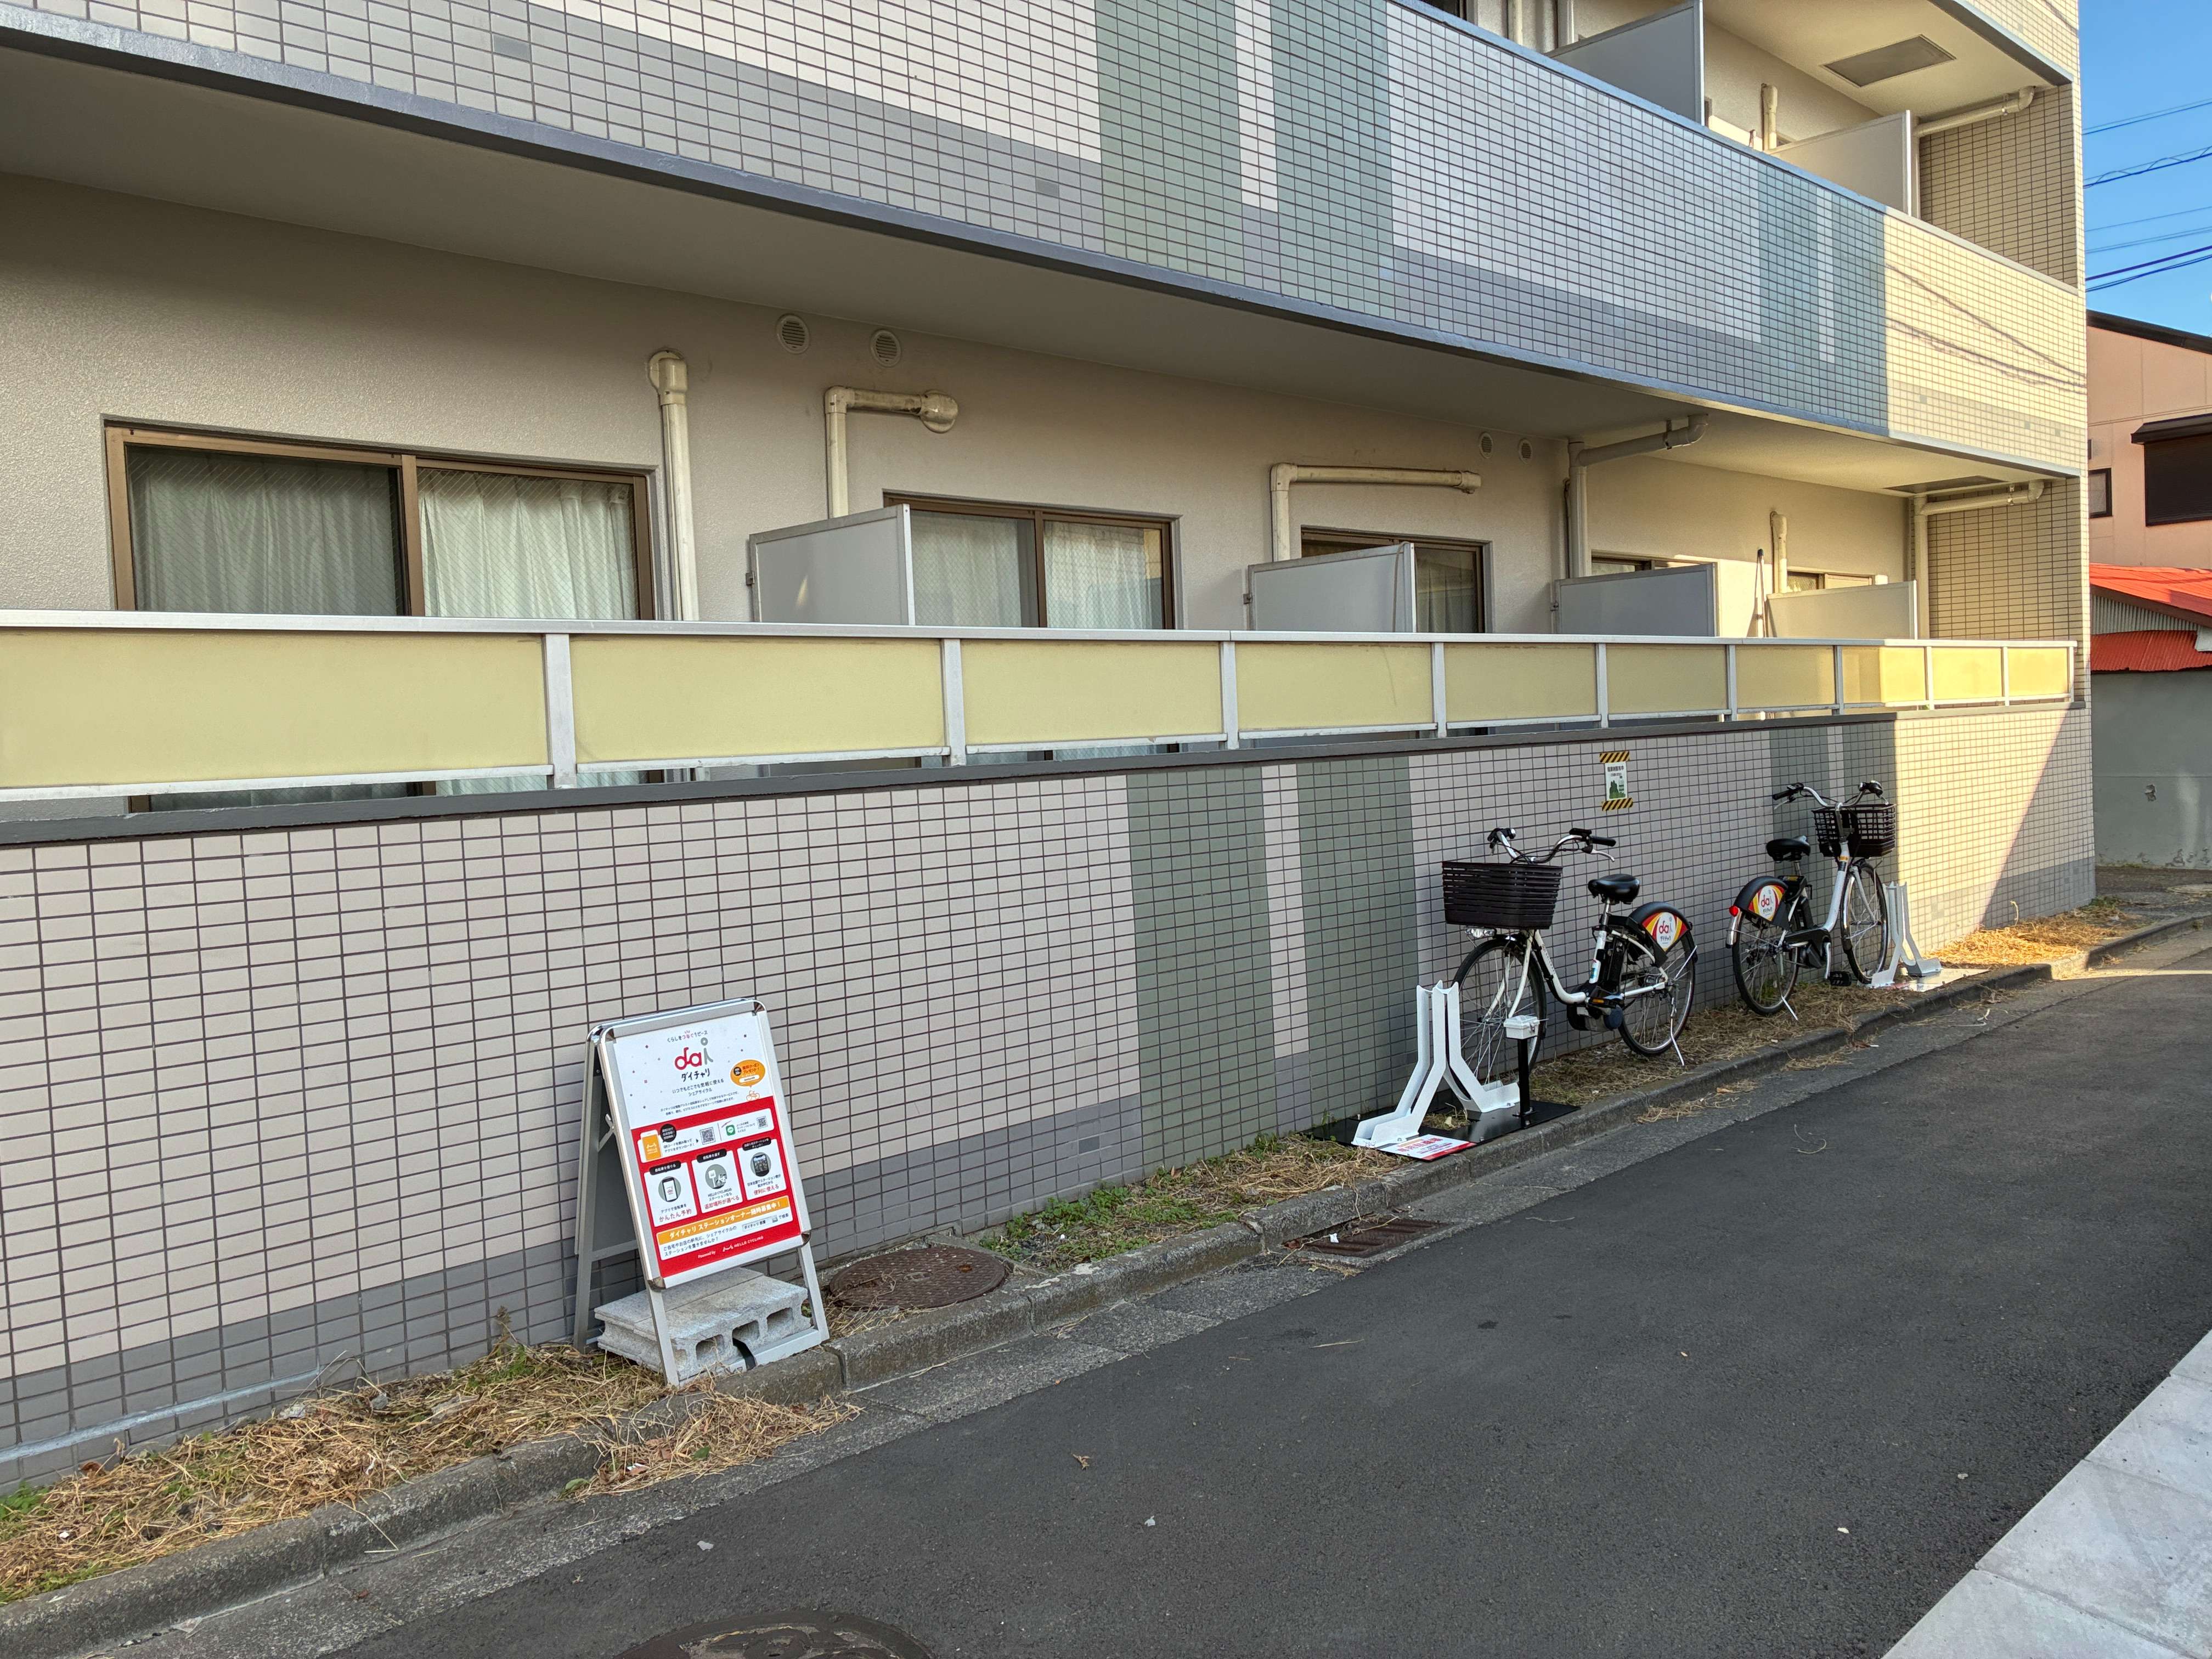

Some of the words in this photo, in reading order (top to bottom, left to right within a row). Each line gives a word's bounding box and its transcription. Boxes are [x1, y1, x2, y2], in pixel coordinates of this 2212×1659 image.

[674, 1037, 714, 1070] dai
[681, 1068, 710, 1082] ダイチャリ
